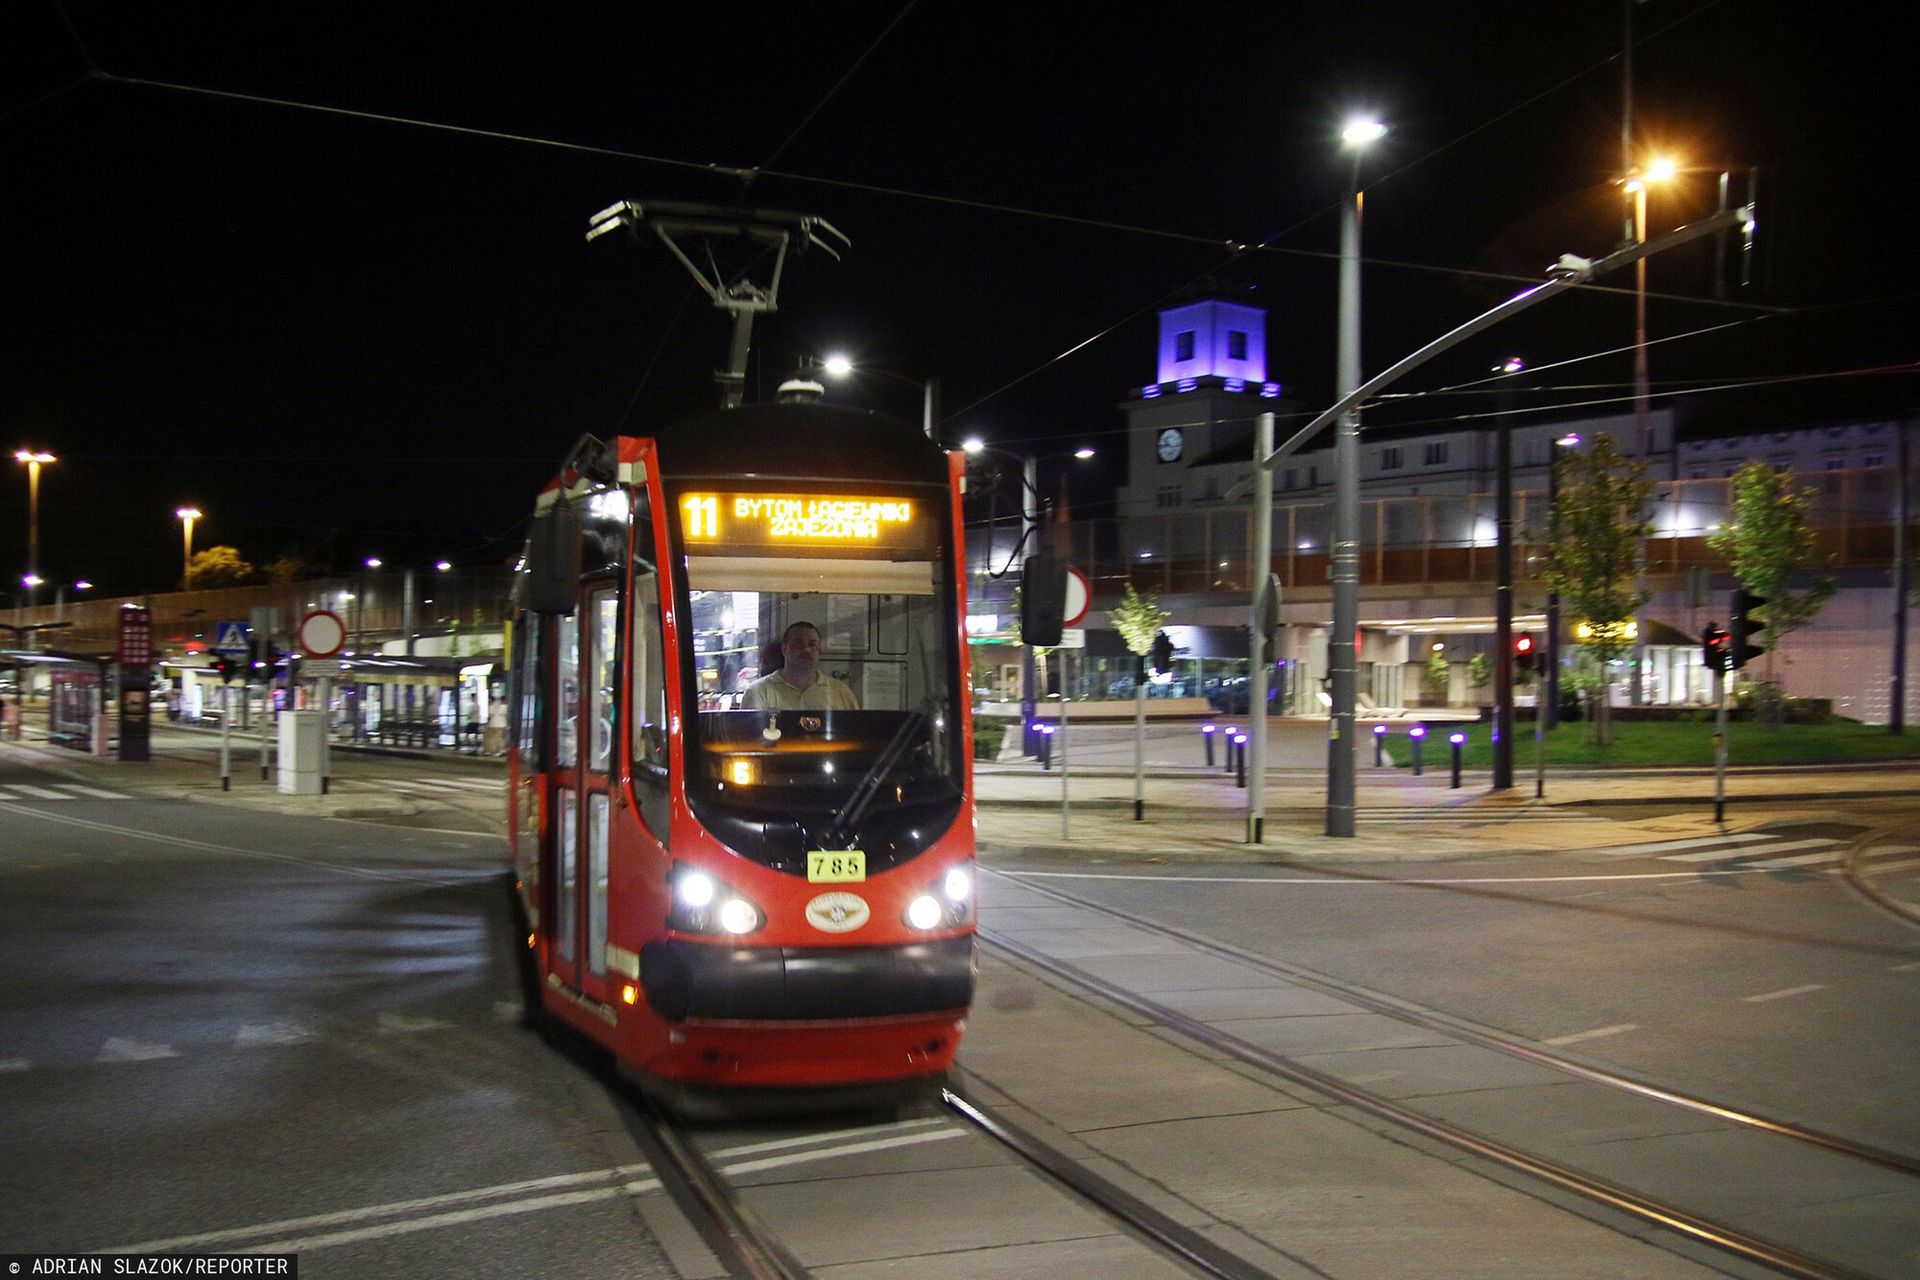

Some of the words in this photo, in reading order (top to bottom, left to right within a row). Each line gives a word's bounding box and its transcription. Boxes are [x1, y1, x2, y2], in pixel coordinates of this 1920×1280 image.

[685, 497, 716, 536] 11
[736, 498, 801, 518] BYTOM
[813, 857, 859, 876] 785
